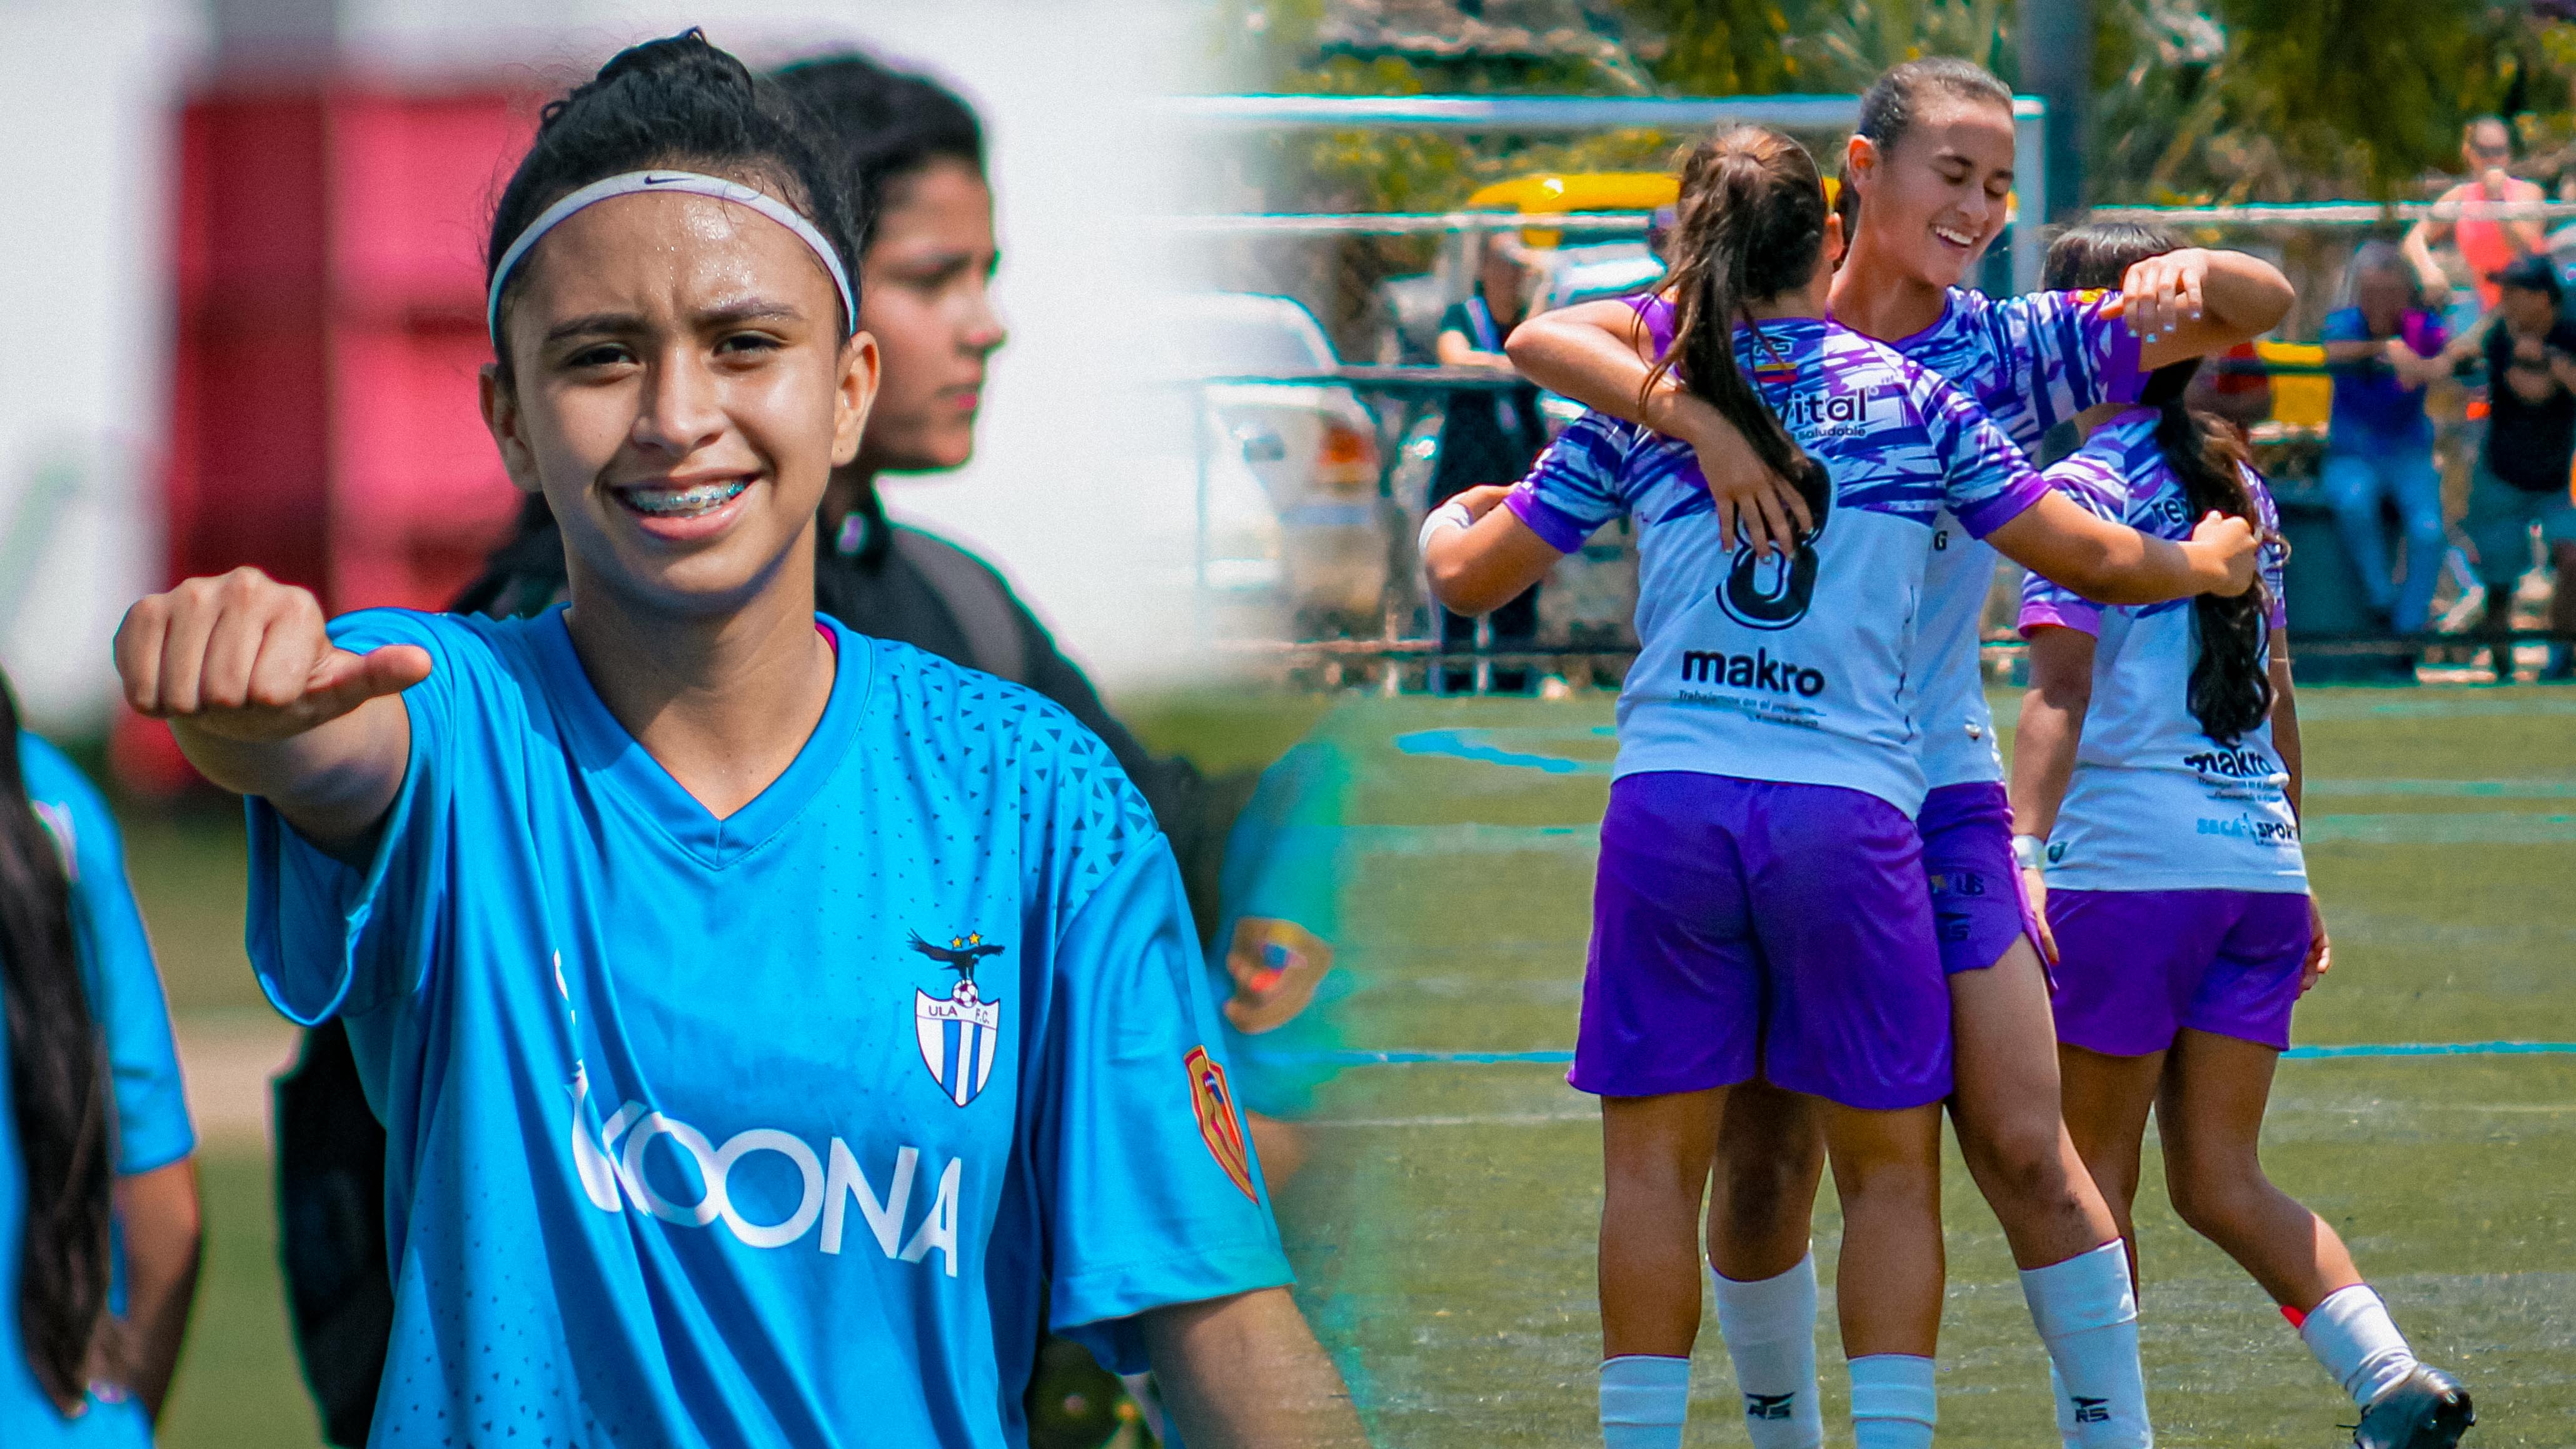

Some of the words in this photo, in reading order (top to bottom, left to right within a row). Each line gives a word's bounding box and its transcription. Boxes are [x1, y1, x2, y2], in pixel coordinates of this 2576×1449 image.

[1682, 646, 1825, 698] makro
[2184, 750, 2277, 778] makro
[928, 1005, 958, 1017] ULA
